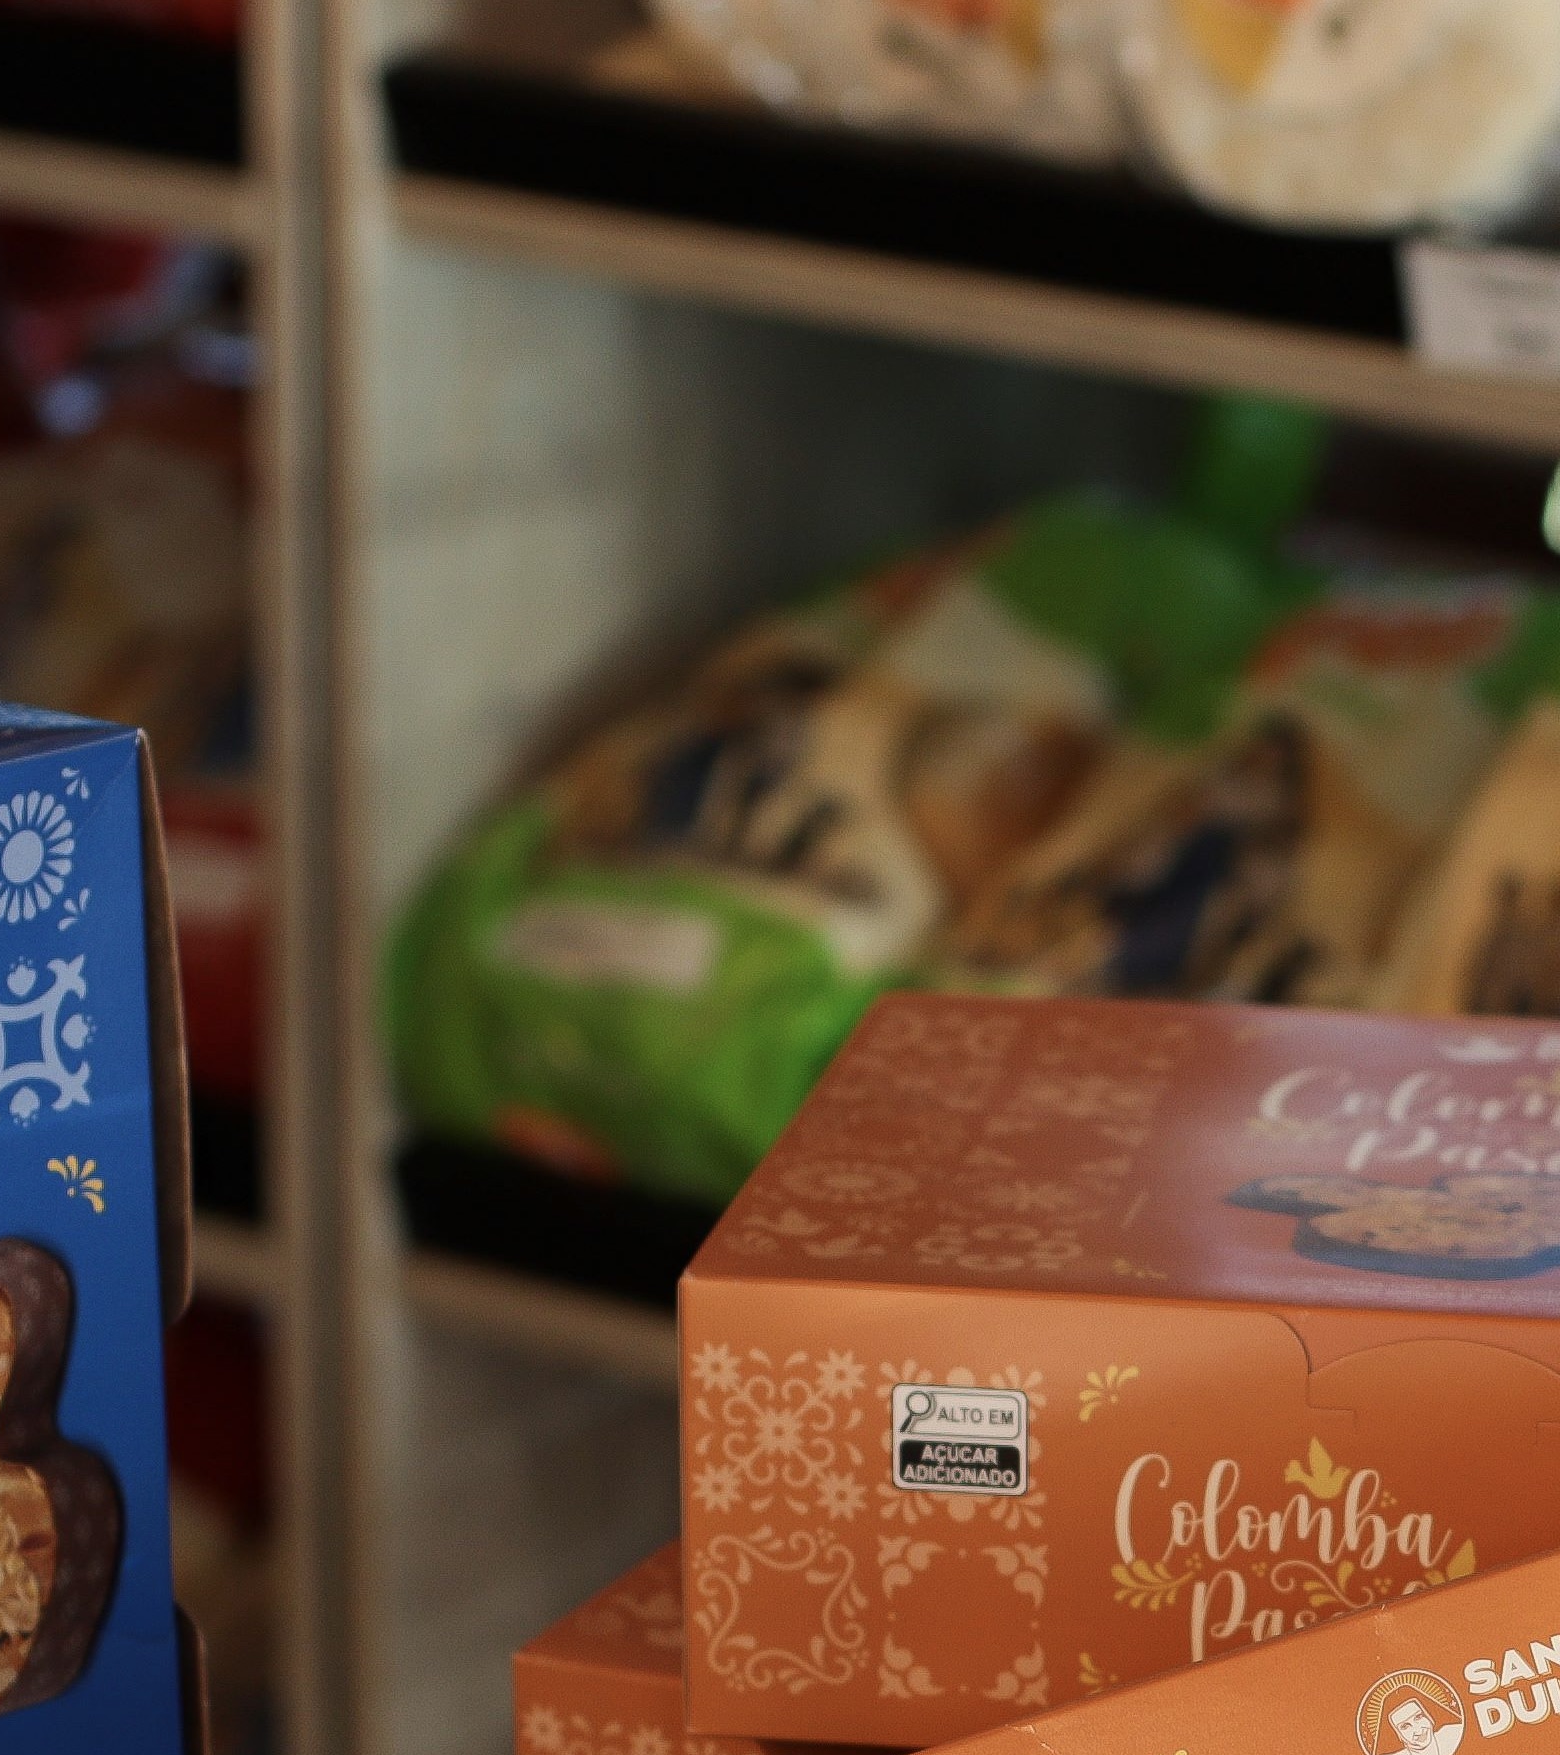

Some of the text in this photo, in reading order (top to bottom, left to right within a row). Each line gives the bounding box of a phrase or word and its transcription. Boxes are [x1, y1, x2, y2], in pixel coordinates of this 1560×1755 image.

[938, 1407, 1013, 1425] ALTO EM
[903, 1464, 1017, 1486] ADICIONADO
[1113, 1452, 1454, 1568] Colomba
